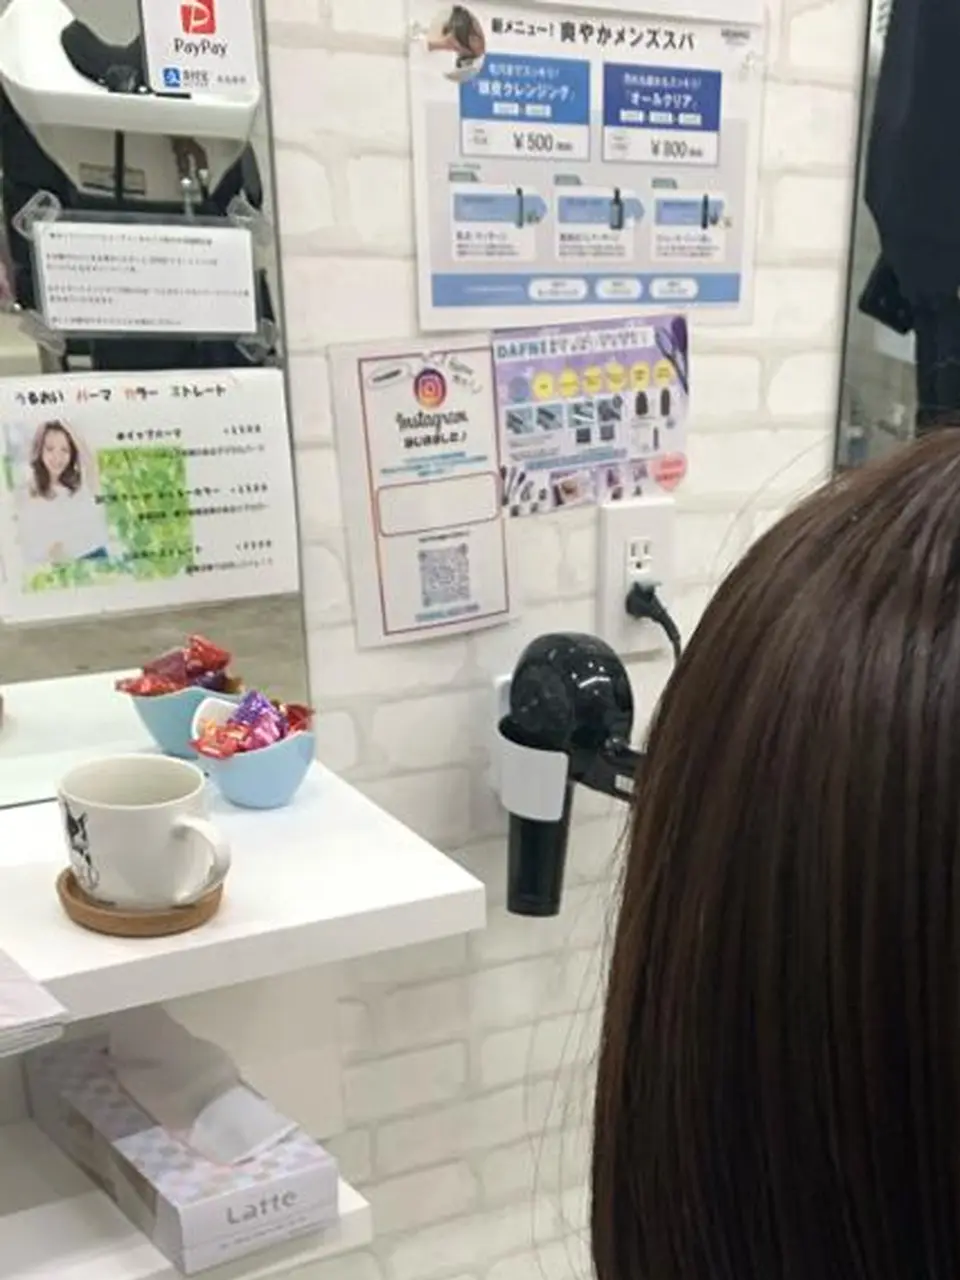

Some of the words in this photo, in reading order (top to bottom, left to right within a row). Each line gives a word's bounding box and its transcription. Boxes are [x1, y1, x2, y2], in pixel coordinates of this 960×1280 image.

[559, 20, 695, 50] 爽やかメンズスパ
[173, 38, 228, 57] PayPay
[170, 384, 227, 398] ストレート
[395, 411, 468, 433] Instagram
[226, 1190, 298, 1225] Latte
